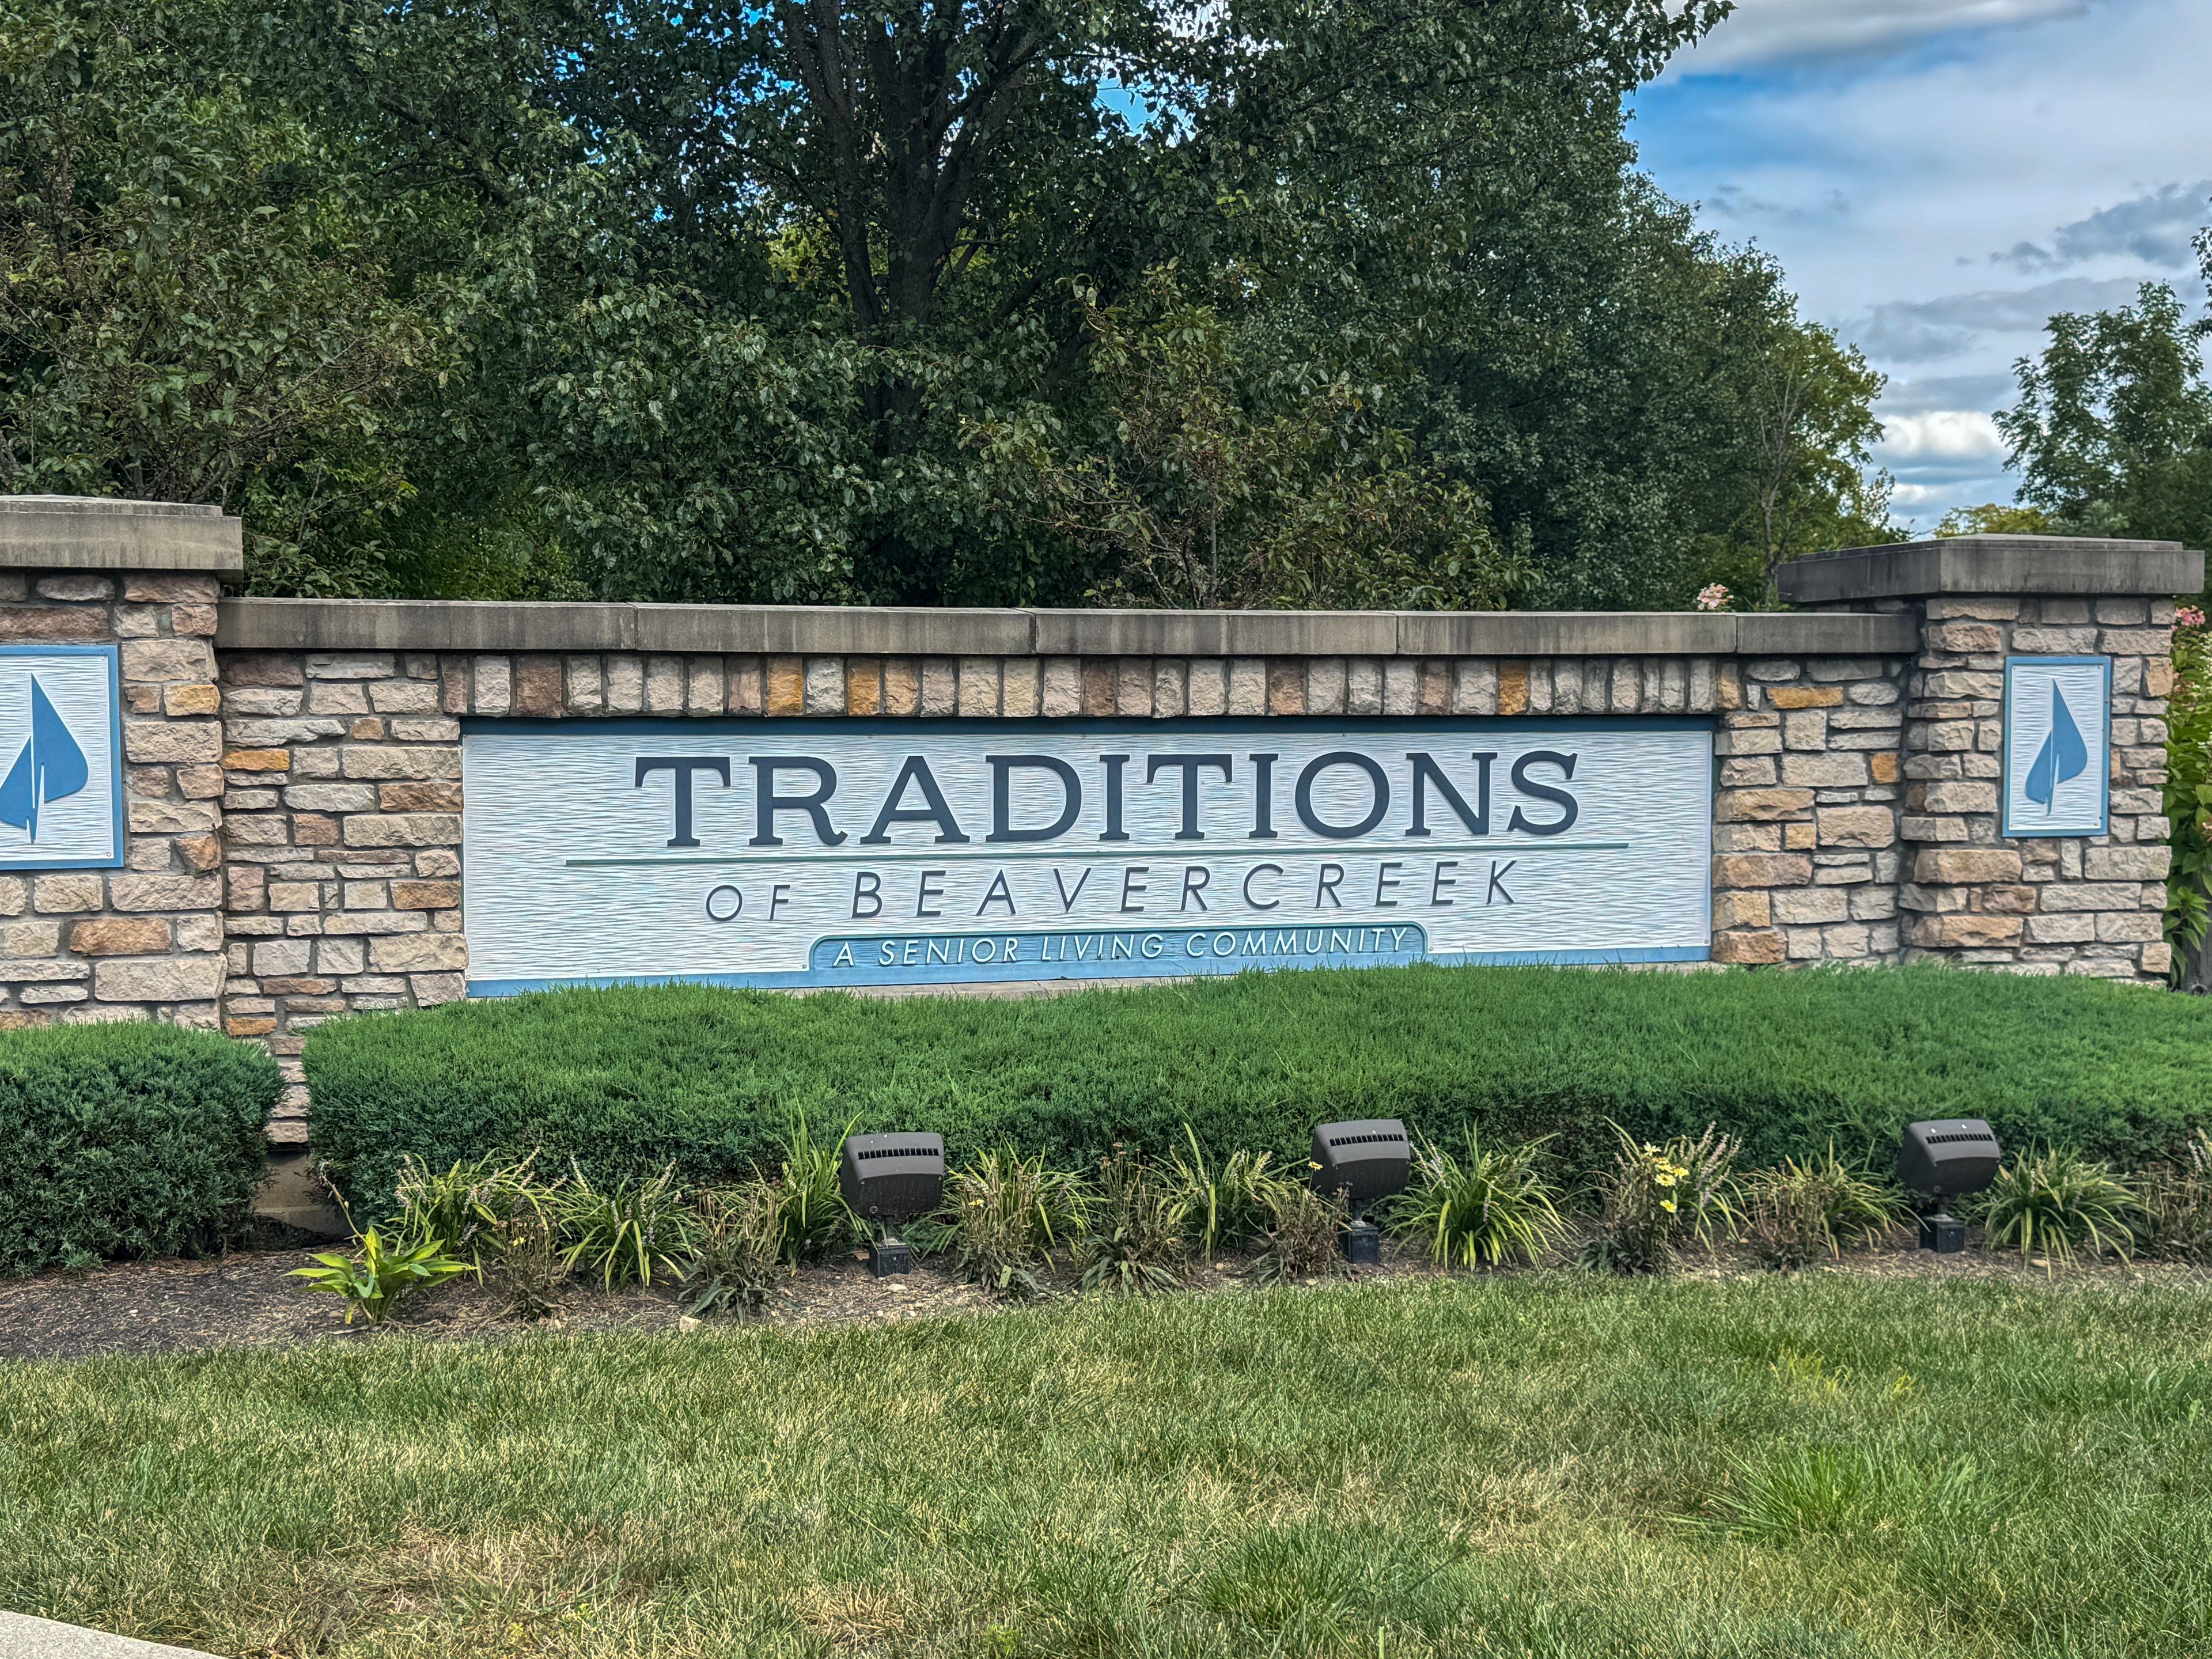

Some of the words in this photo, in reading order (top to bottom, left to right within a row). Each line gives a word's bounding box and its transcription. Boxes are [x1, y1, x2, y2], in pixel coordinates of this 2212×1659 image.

[634, 750, 1580, 847] TRADITIONS
[705, 884, 791, 921] OF
[851, 859, 1518, 919] BEAVERCREEK
[833, 941, 855, 968] A
[878, 938, 1019, 966] SENIOR
[1041, 932, 1164, 961] LIVING
[1185, 927, 1408, 957] COMMUNITY
